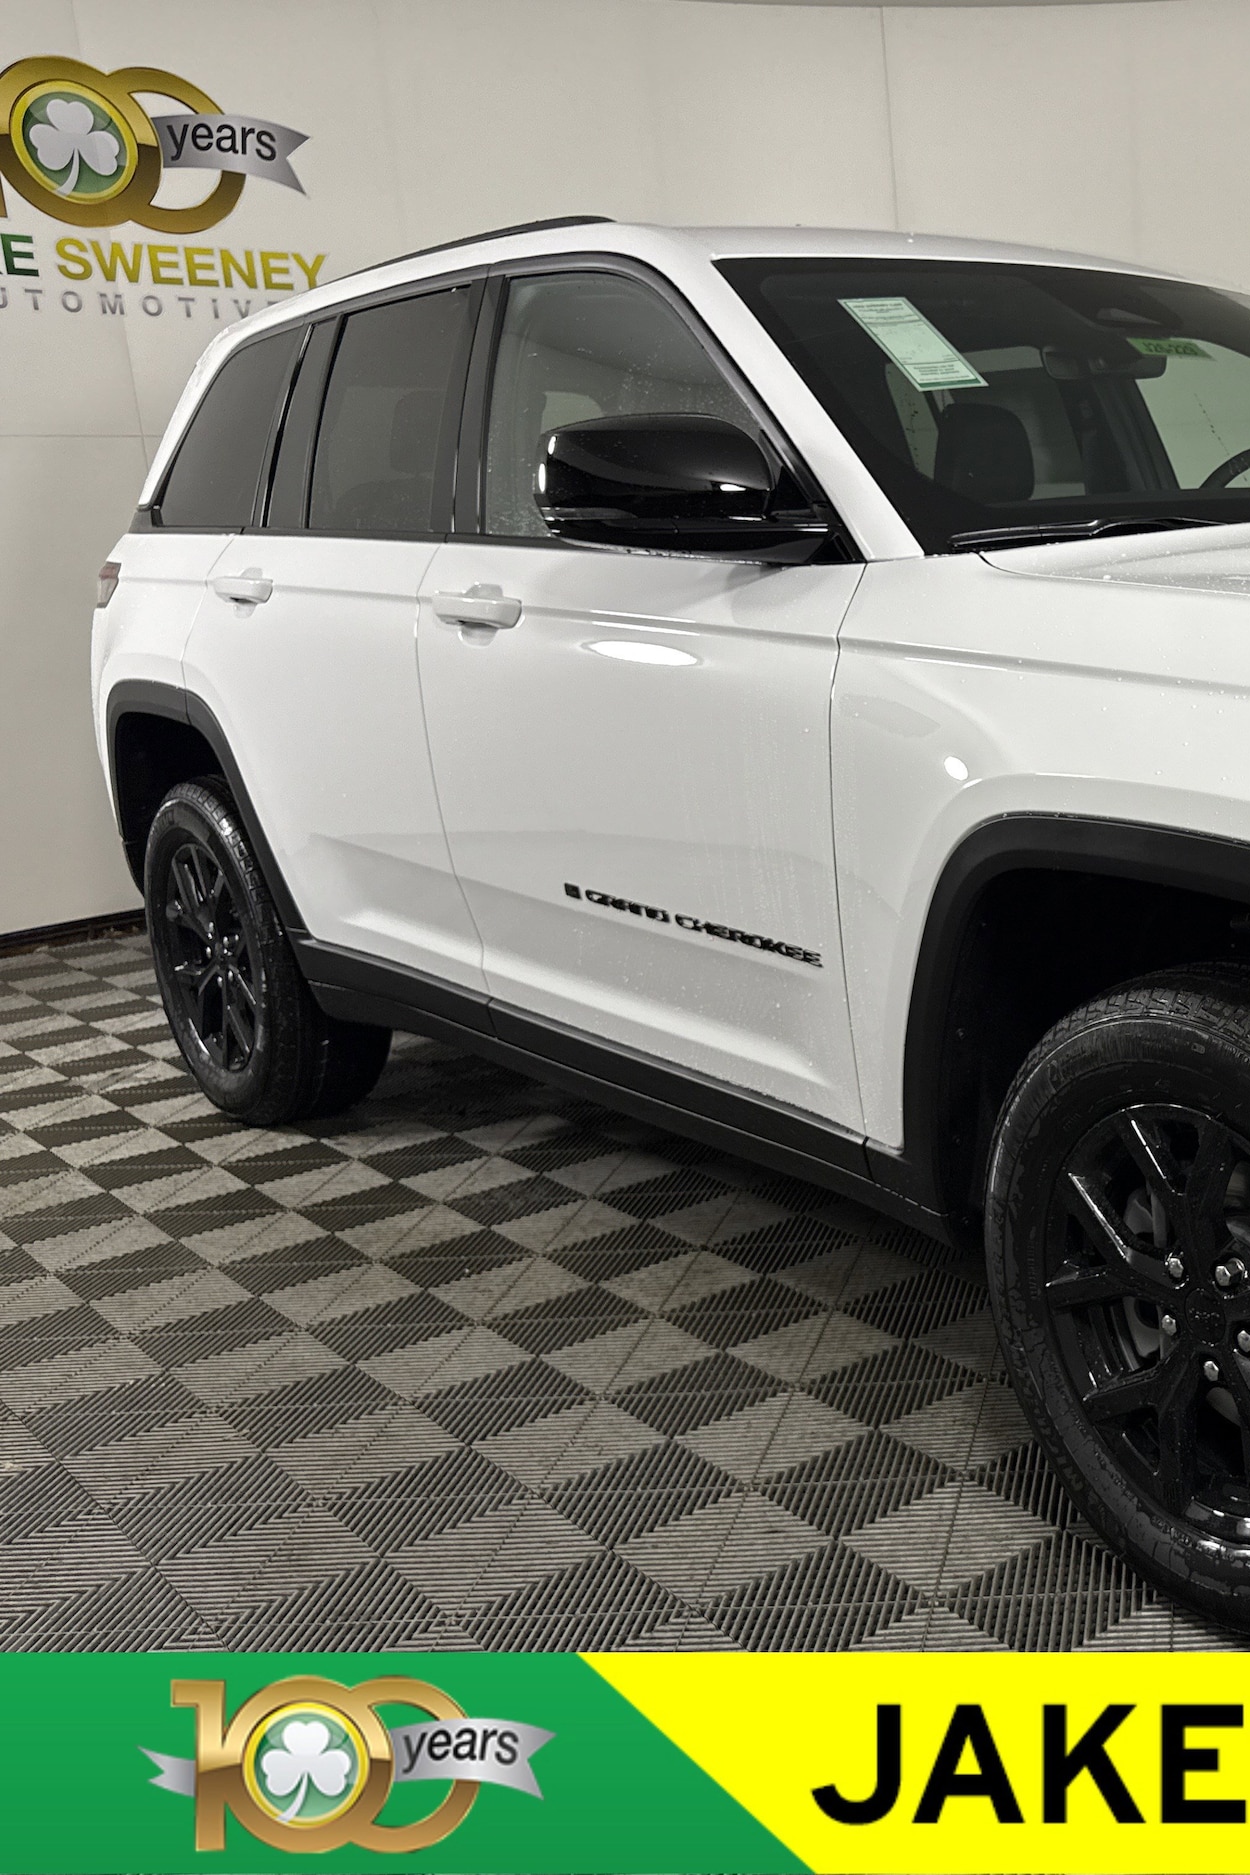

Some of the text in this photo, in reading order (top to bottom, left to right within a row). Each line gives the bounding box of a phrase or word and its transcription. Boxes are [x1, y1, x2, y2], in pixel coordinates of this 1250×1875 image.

[166, 121, 277, 161] years
[55, 237, 326, 291] SWEENEY
[675, 913, 824, 968] CHEROKEE
